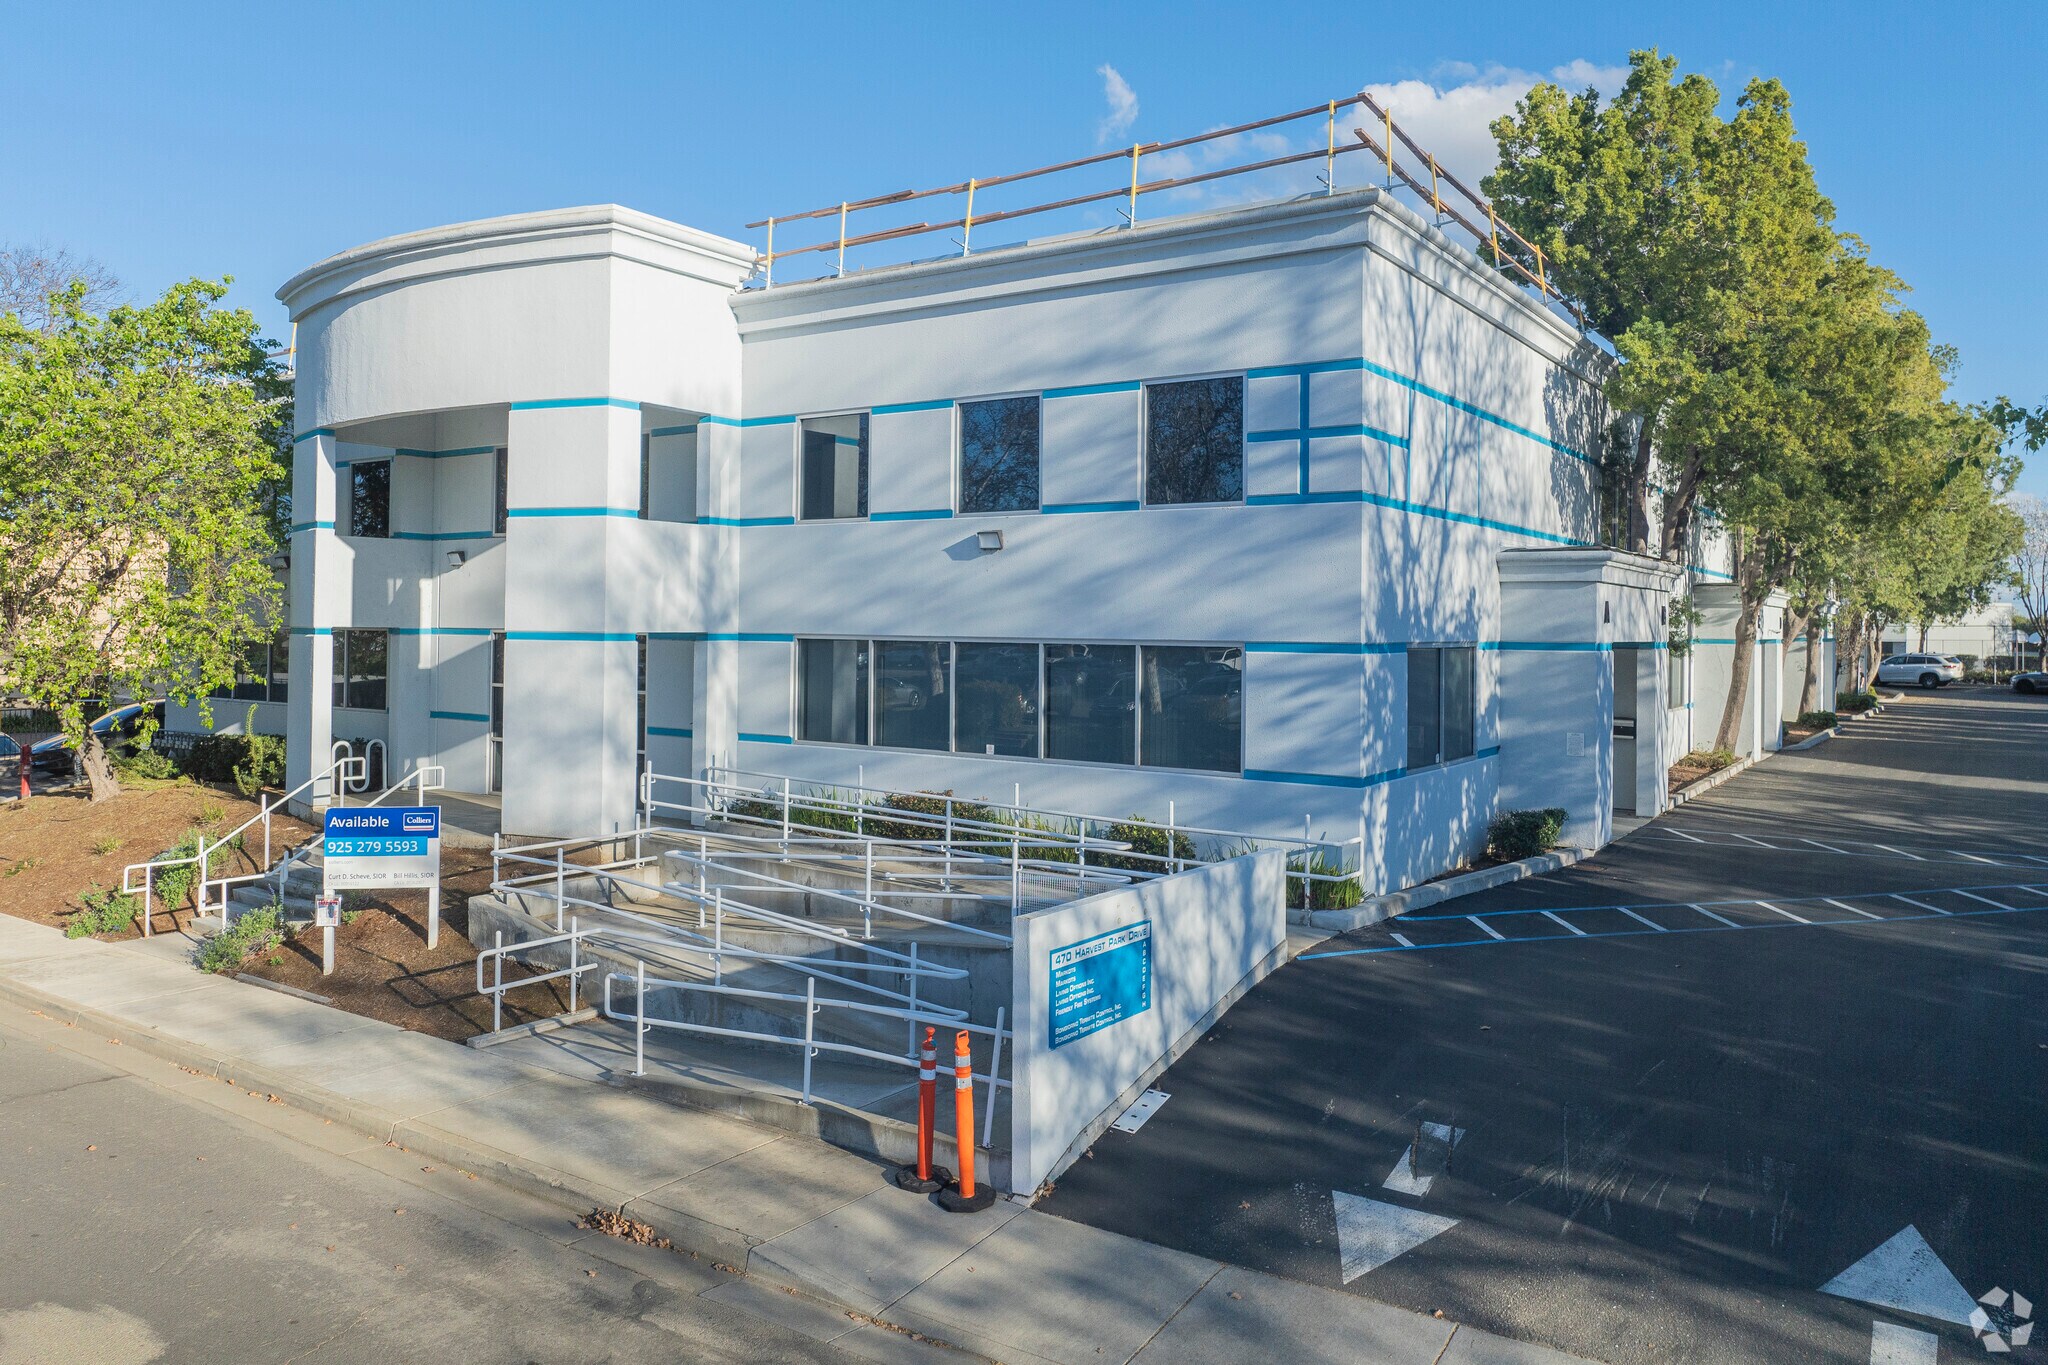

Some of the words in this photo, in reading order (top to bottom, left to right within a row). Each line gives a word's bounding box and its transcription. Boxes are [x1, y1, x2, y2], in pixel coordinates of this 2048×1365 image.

[329, 816, 390, 828] Available
[406, 816, 432, 824] Colliers
[328, 841, 353, 853] 925
[356, 841, 382, 853] 279
[385, 841, 418, 852] 5593
[1055, 951, 1072, 965] 470
